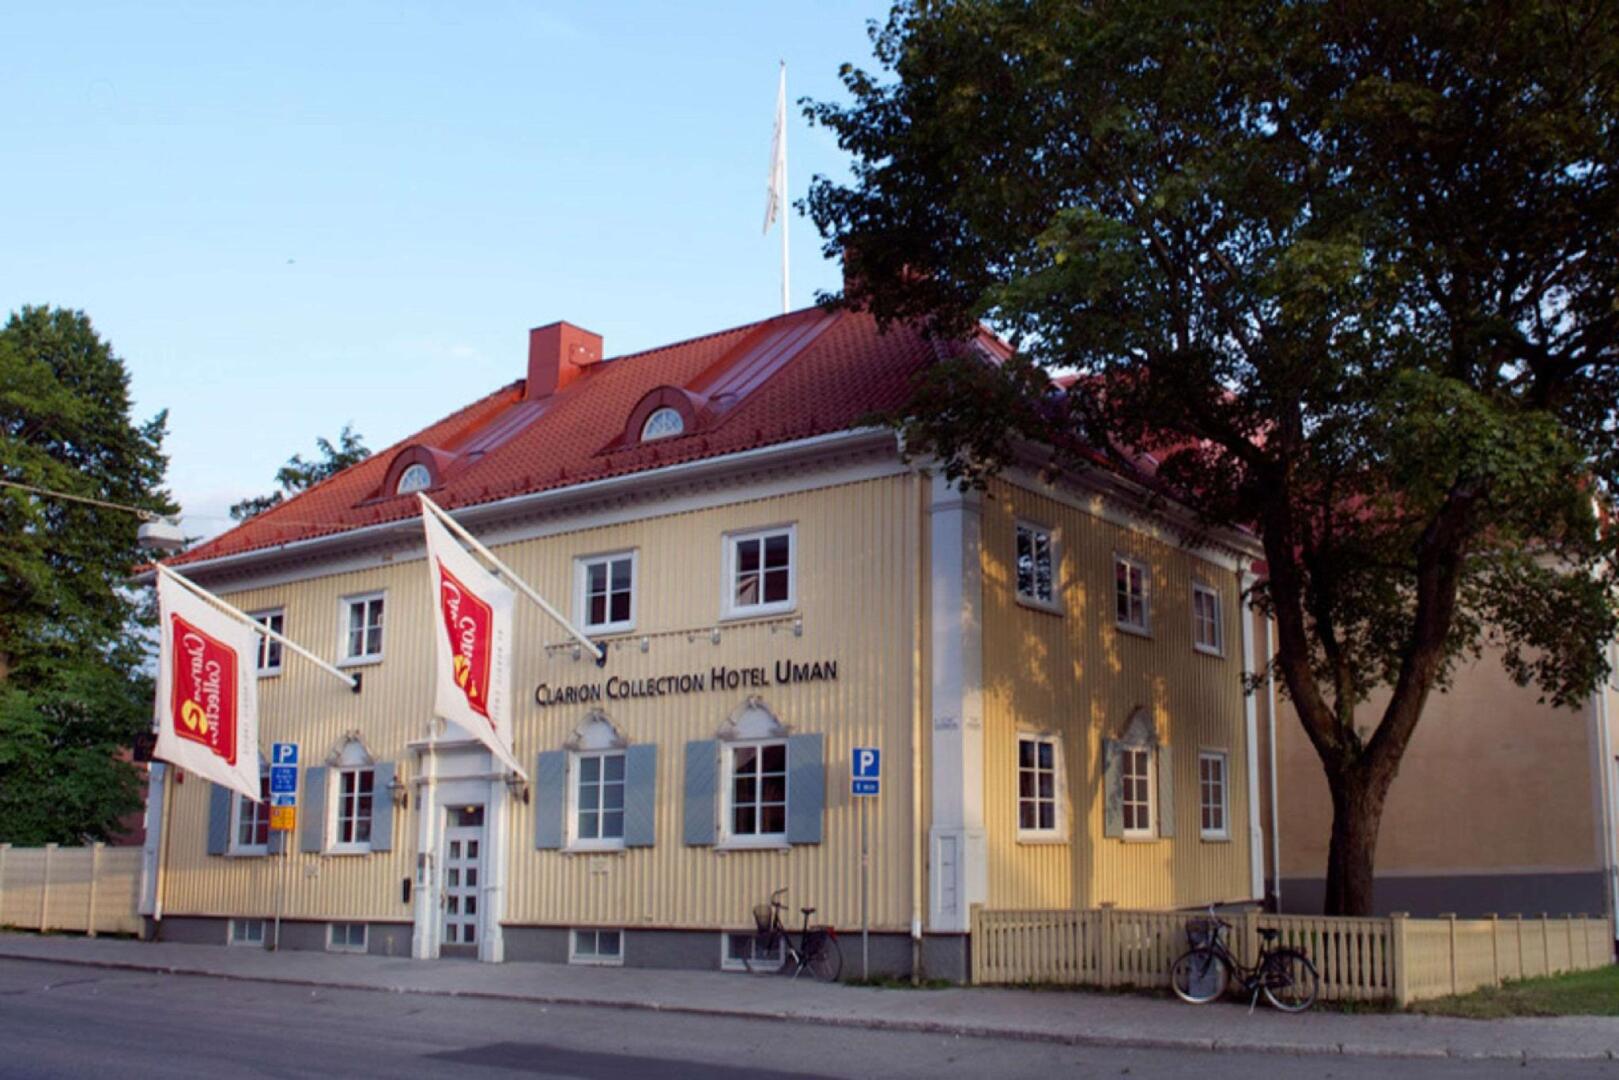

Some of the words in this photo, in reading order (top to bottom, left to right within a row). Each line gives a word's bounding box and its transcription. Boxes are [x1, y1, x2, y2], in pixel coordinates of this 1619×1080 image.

[535, 683, 601, 706] CLARION
[608, 673, 704, 700] COLLECTION
[711, 665, 770, 691] HOTEL
[775, 658, 838, 684] UMAN
[279, 745, 293, 763] P
[860, 750, 875, 776] P
